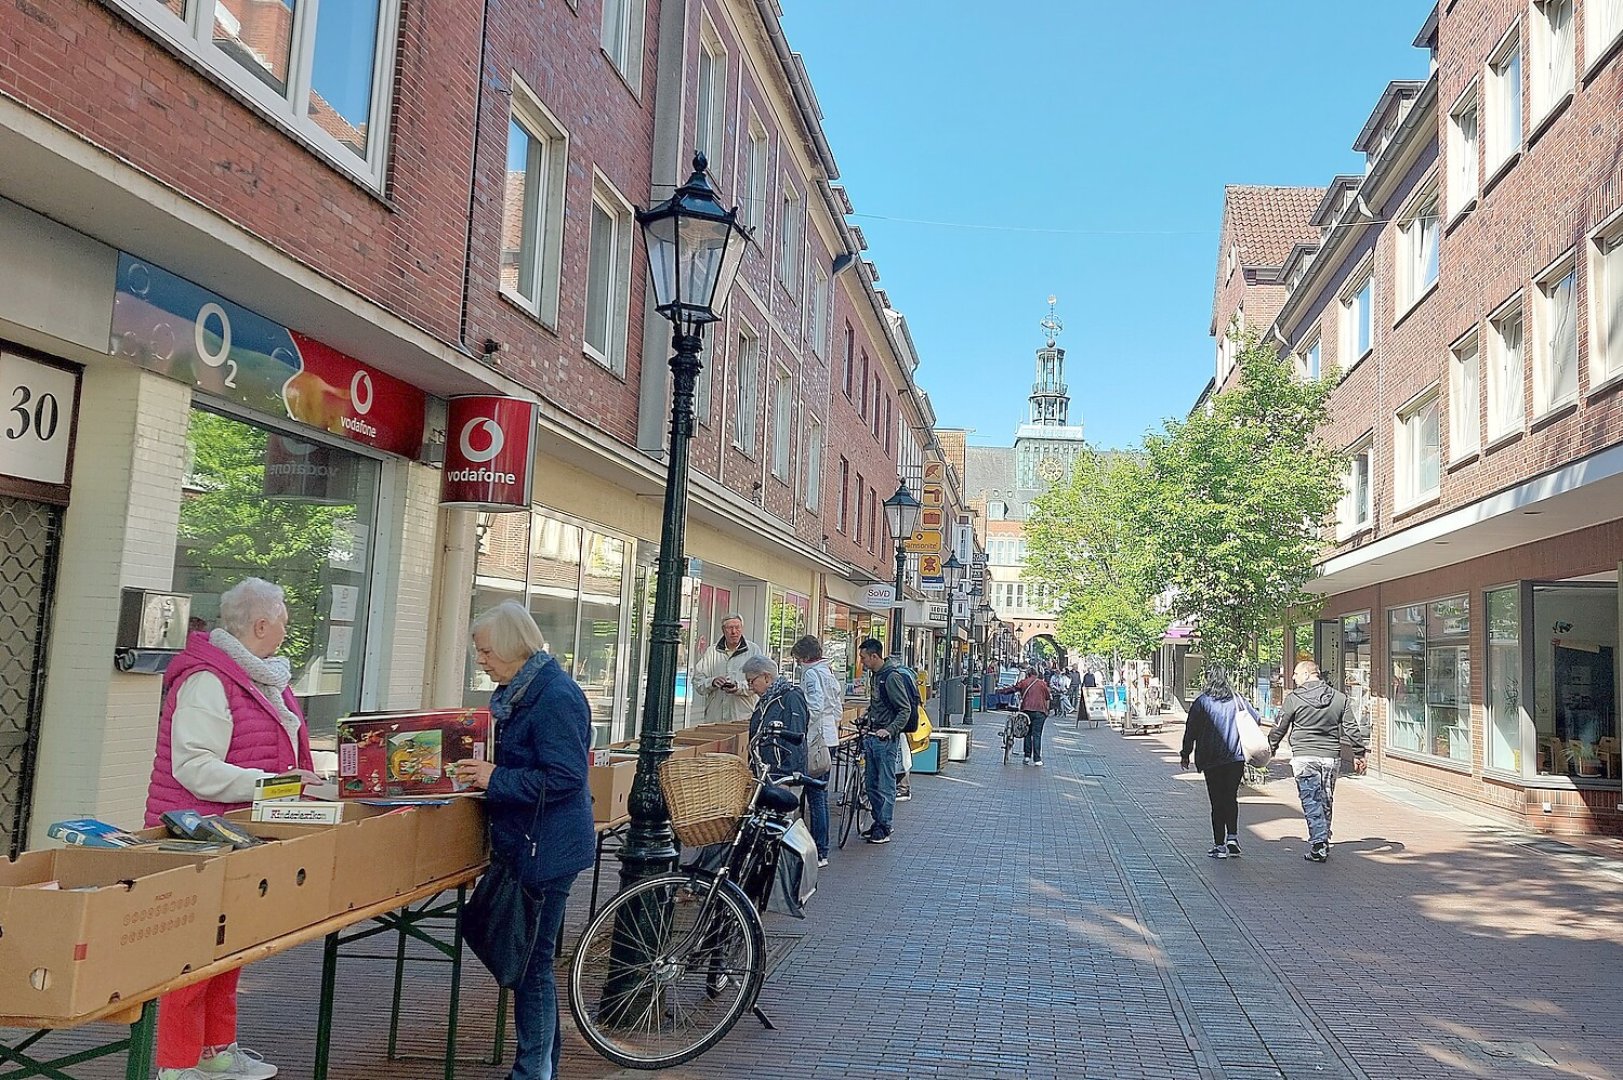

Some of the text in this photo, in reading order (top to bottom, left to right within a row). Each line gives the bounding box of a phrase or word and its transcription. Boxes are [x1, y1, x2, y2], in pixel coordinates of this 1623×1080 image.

[6, 385, 59, 441] 30
[340, 415, 377, 438] vodafone
[448, 467, 516, 485] vodafone
[868, 589, 891, 598] SoVD
